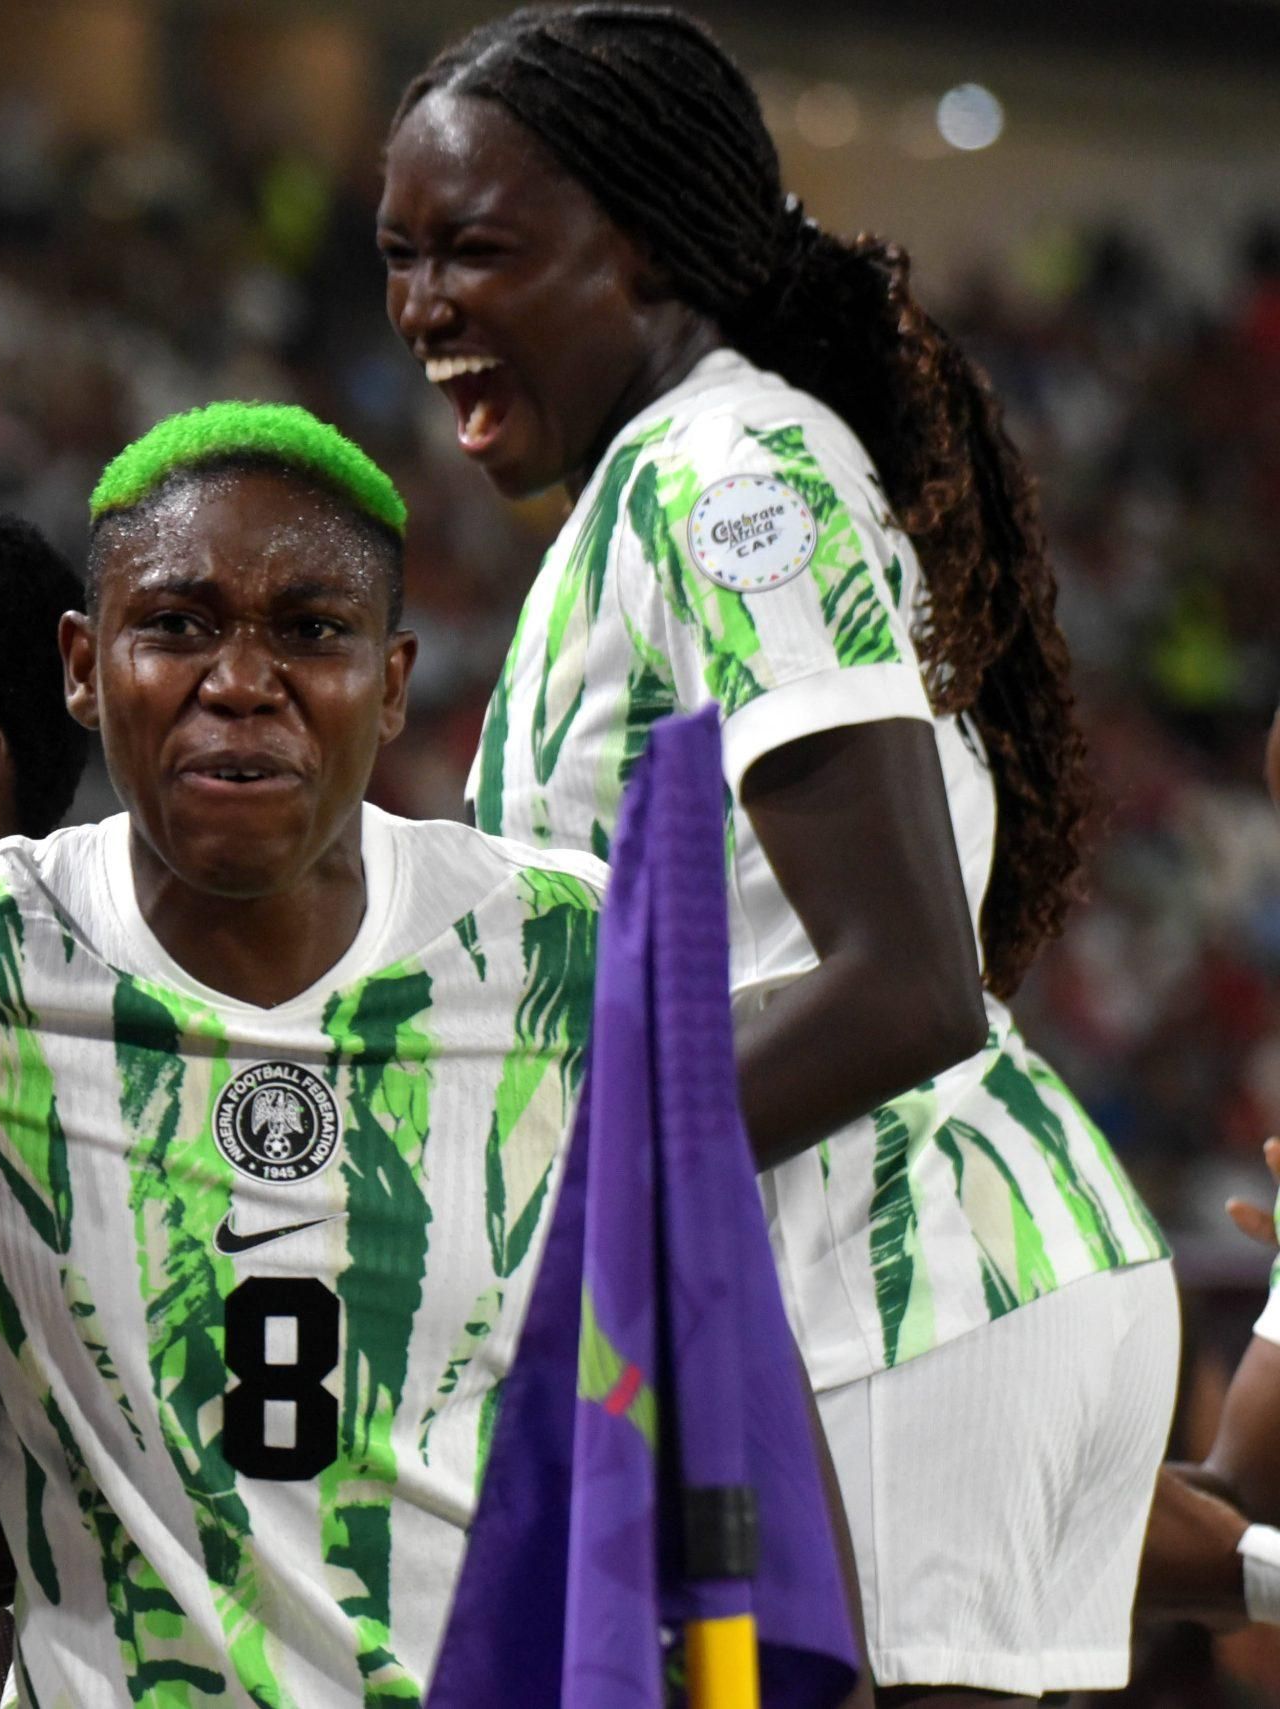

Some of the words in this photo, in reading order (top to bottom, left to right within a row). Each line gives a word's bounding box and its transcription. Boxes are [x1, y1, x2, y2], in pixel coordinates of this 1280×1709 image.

[711, 505, 784, 545] Celebrate
[729, 521, 774, 549] Africa
[736, 534, 778, 558] CAF
[227, 1066, 300, 1103] FOOTBALL
[219, 1101, 246, 1162] NIGERIA
[301, 1076, 336, 1166] FEDERATION
[262, 1165, 297, 1179] 1945
[222, 1276, 340, 1481] 8
